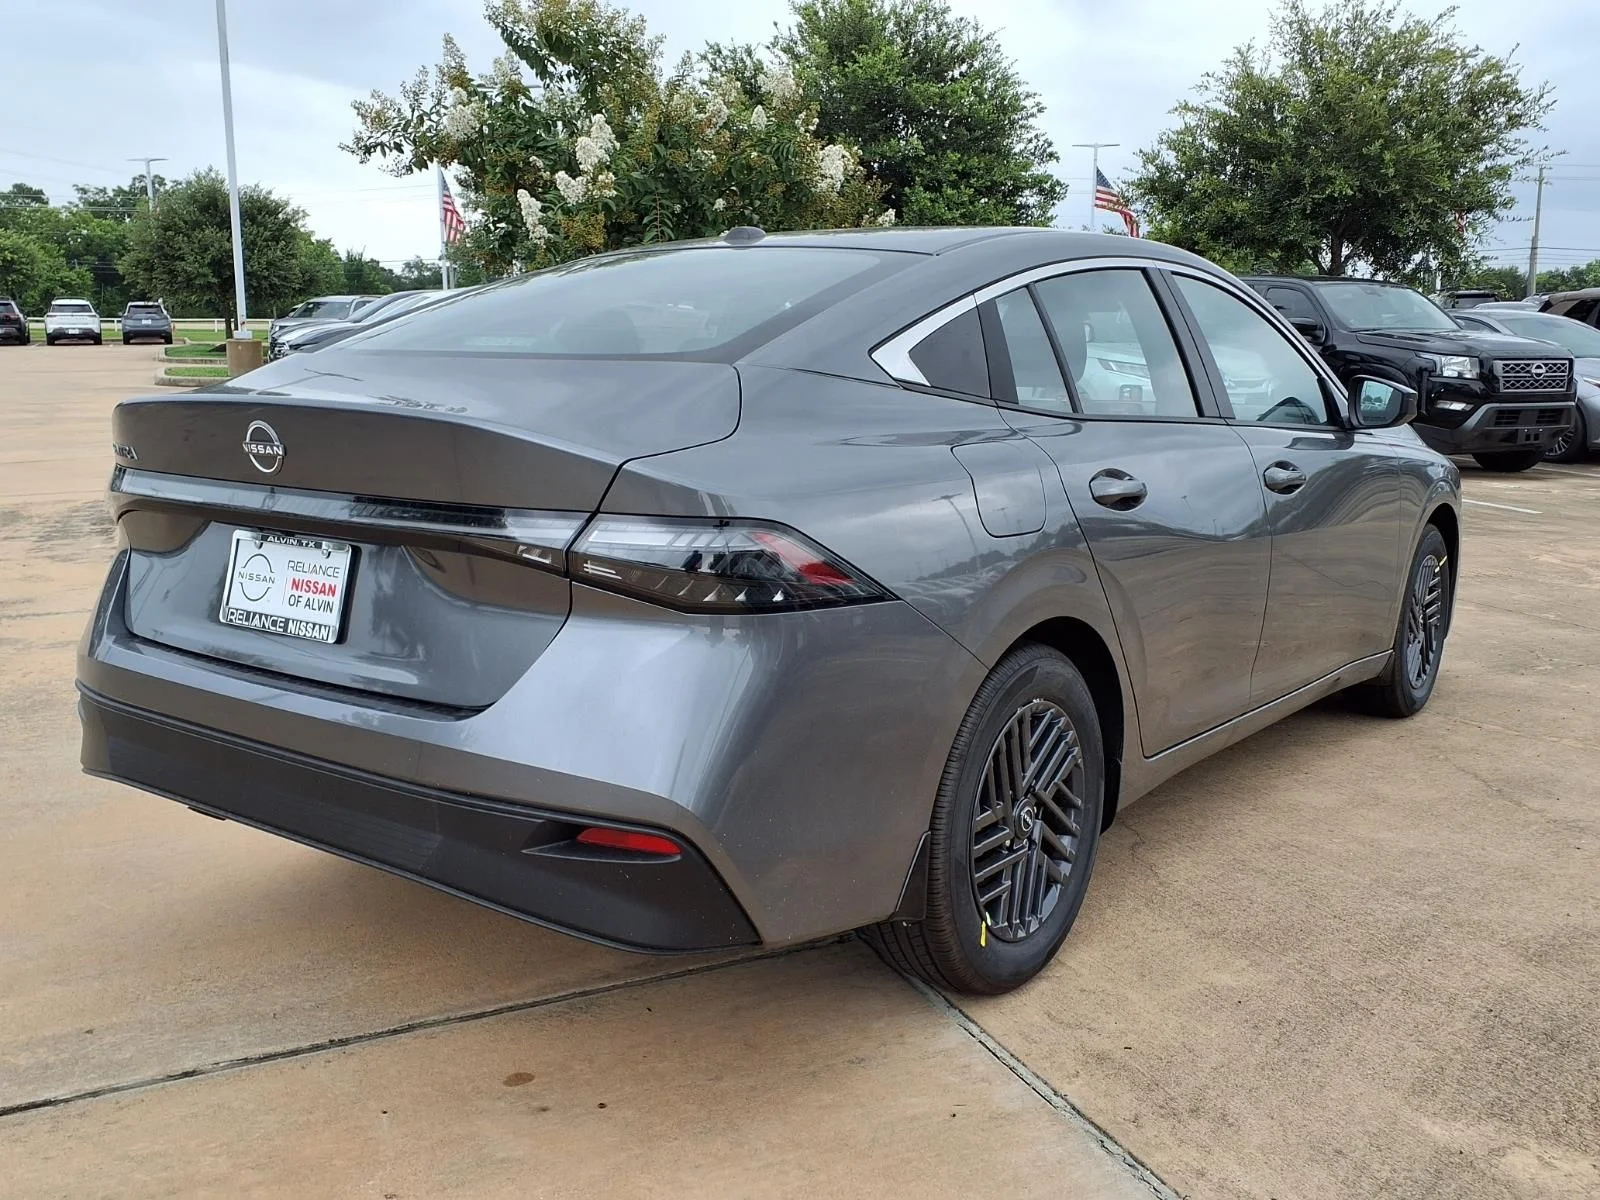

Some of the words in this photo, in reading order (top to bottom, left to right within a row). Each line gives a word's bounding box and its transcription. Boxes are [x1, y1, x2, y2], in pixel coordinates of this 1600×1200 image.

[243, 443, 283, 456] NISSAN
[302, 540, 316, 548] TX
[238, 571, 276, 584] NISSAN
[287, 560, 340, 578] RELIANCE
[291, 578, 337, 597] NISSAN
[288, 594, 302, 608] OF
[304, 597, 335, 614] ALVIN
[227, 608, 286, 632] RELIANCE
[287, 621, 329, 640] NISSAN
